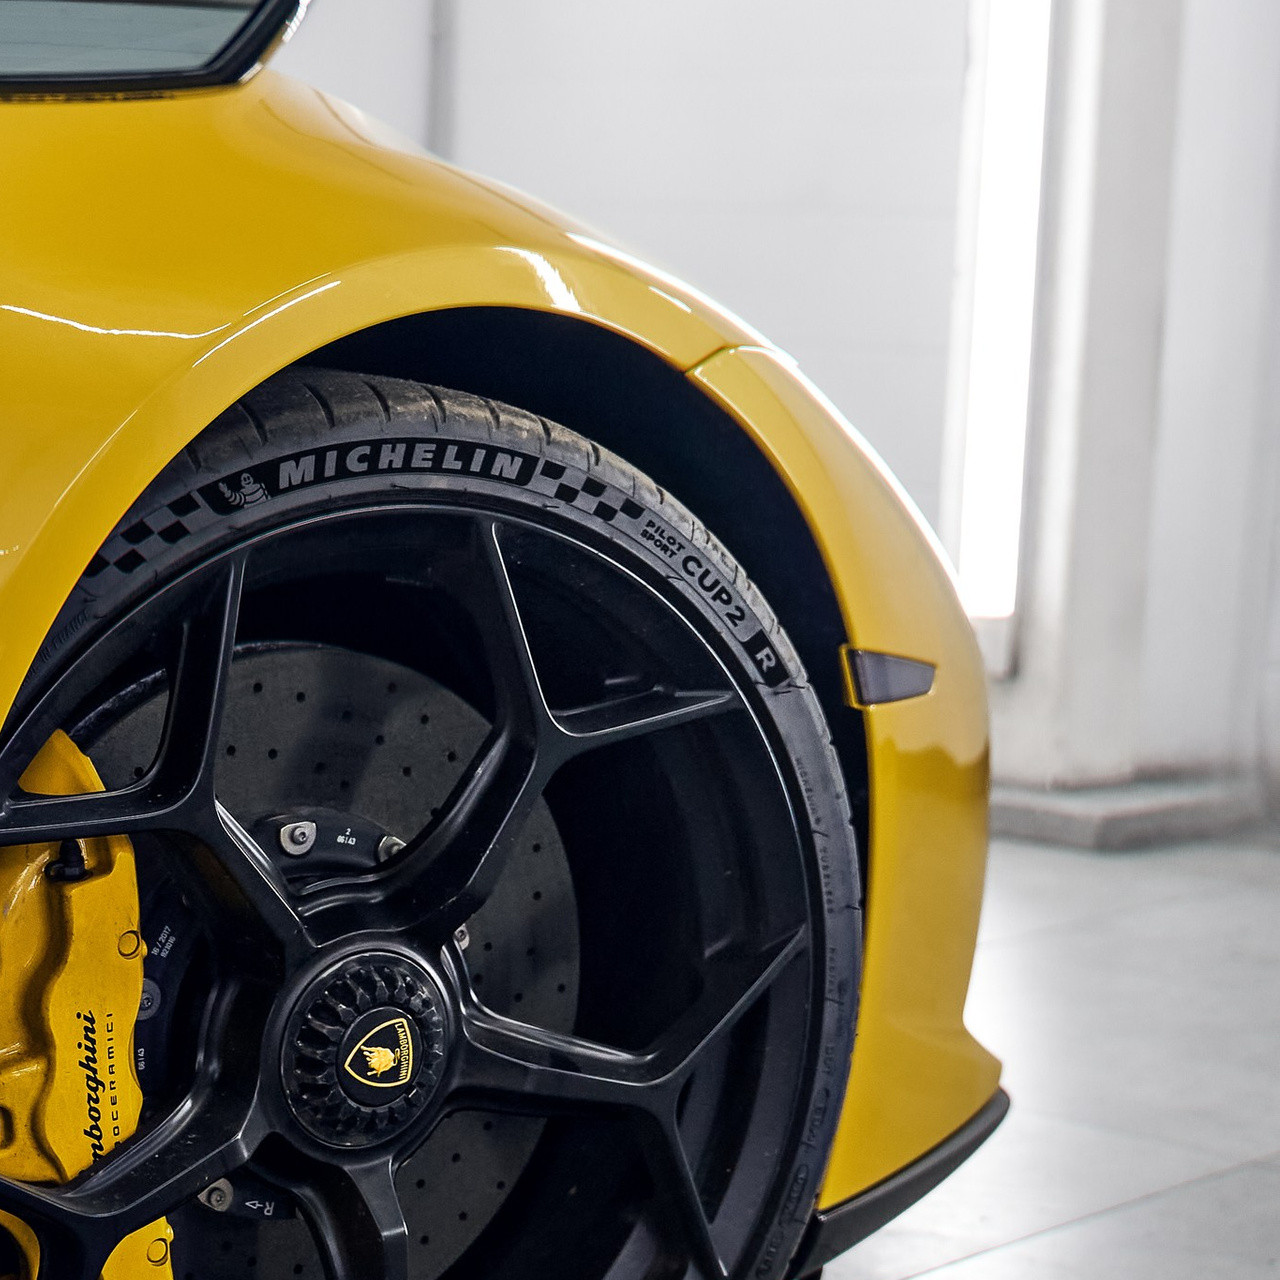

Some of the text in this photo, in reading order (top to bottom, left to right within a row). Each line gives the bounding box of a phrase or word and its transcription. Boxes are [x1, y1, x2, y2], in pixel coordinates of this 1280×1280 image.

[278, 442, 524, 490] MICHELIN
[640, 529, 679, 559] SPORT
[645, 519, 686, 552] PILOT
[755, 646, 776, 674] R
[158, 925, 171, 943] 2017
[394, 1023, 409, 1079] LAMBORGHINI
[264, 1201, 275, 1216] R
